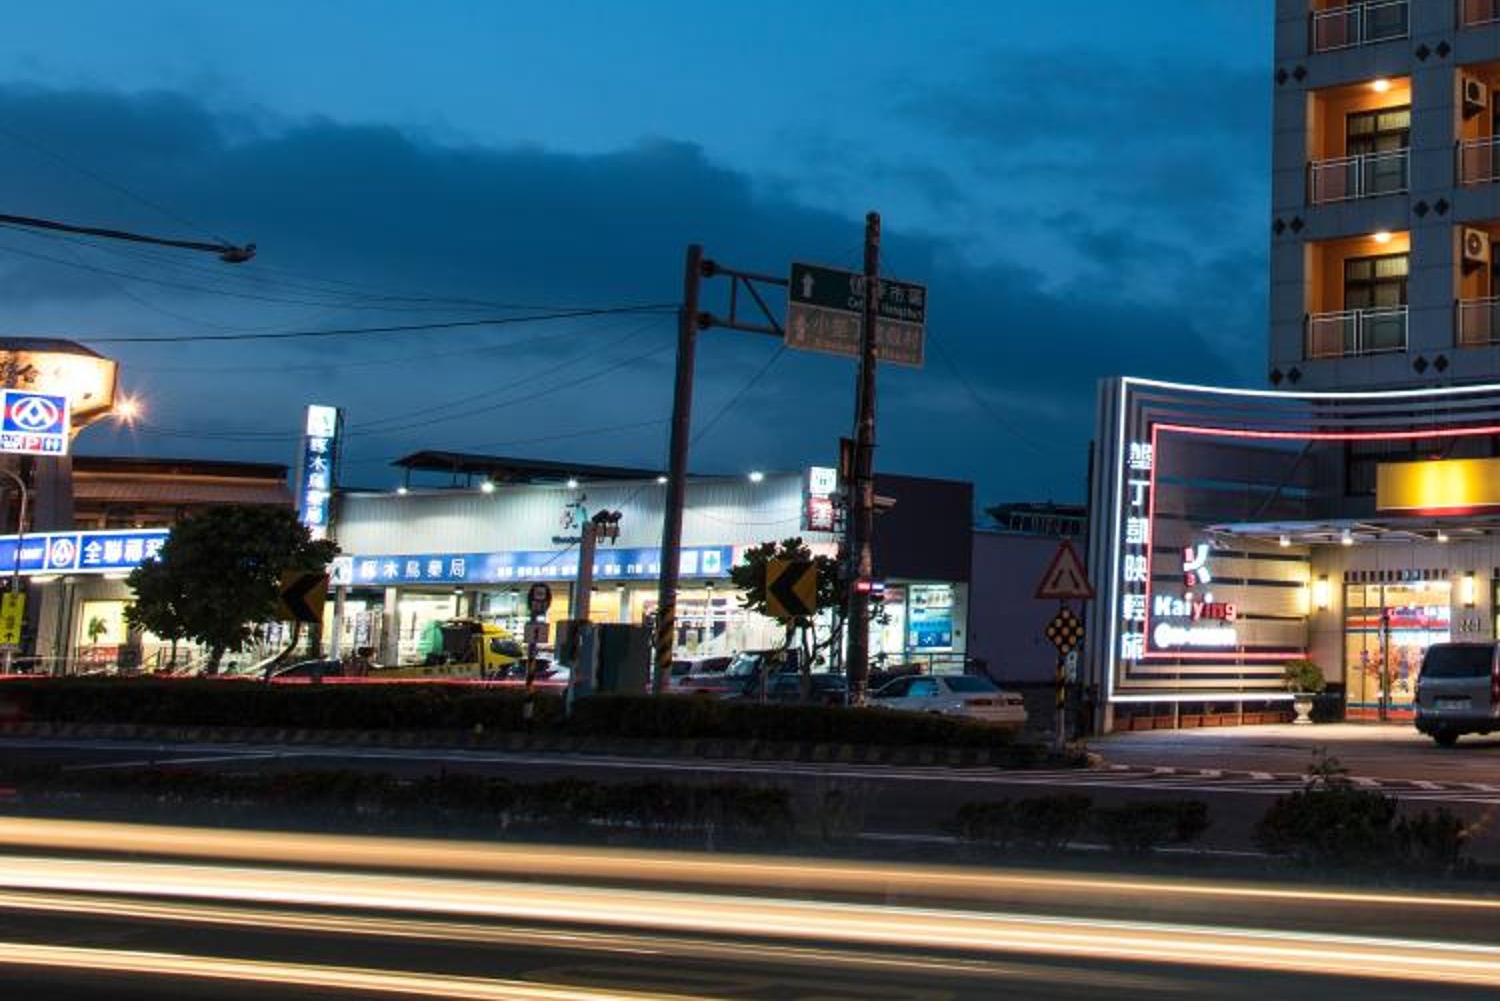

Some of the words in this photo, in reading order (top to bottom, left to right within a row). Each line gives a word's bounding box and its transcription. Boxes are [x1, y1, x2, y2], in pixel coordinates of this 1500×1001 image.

[1121, 442, 1152, 659] 墾丁凱映輕旅
[361, 559, 465, 579] 啄木鳥藥局
[1154, 592, 1237, 621] Kaiying
